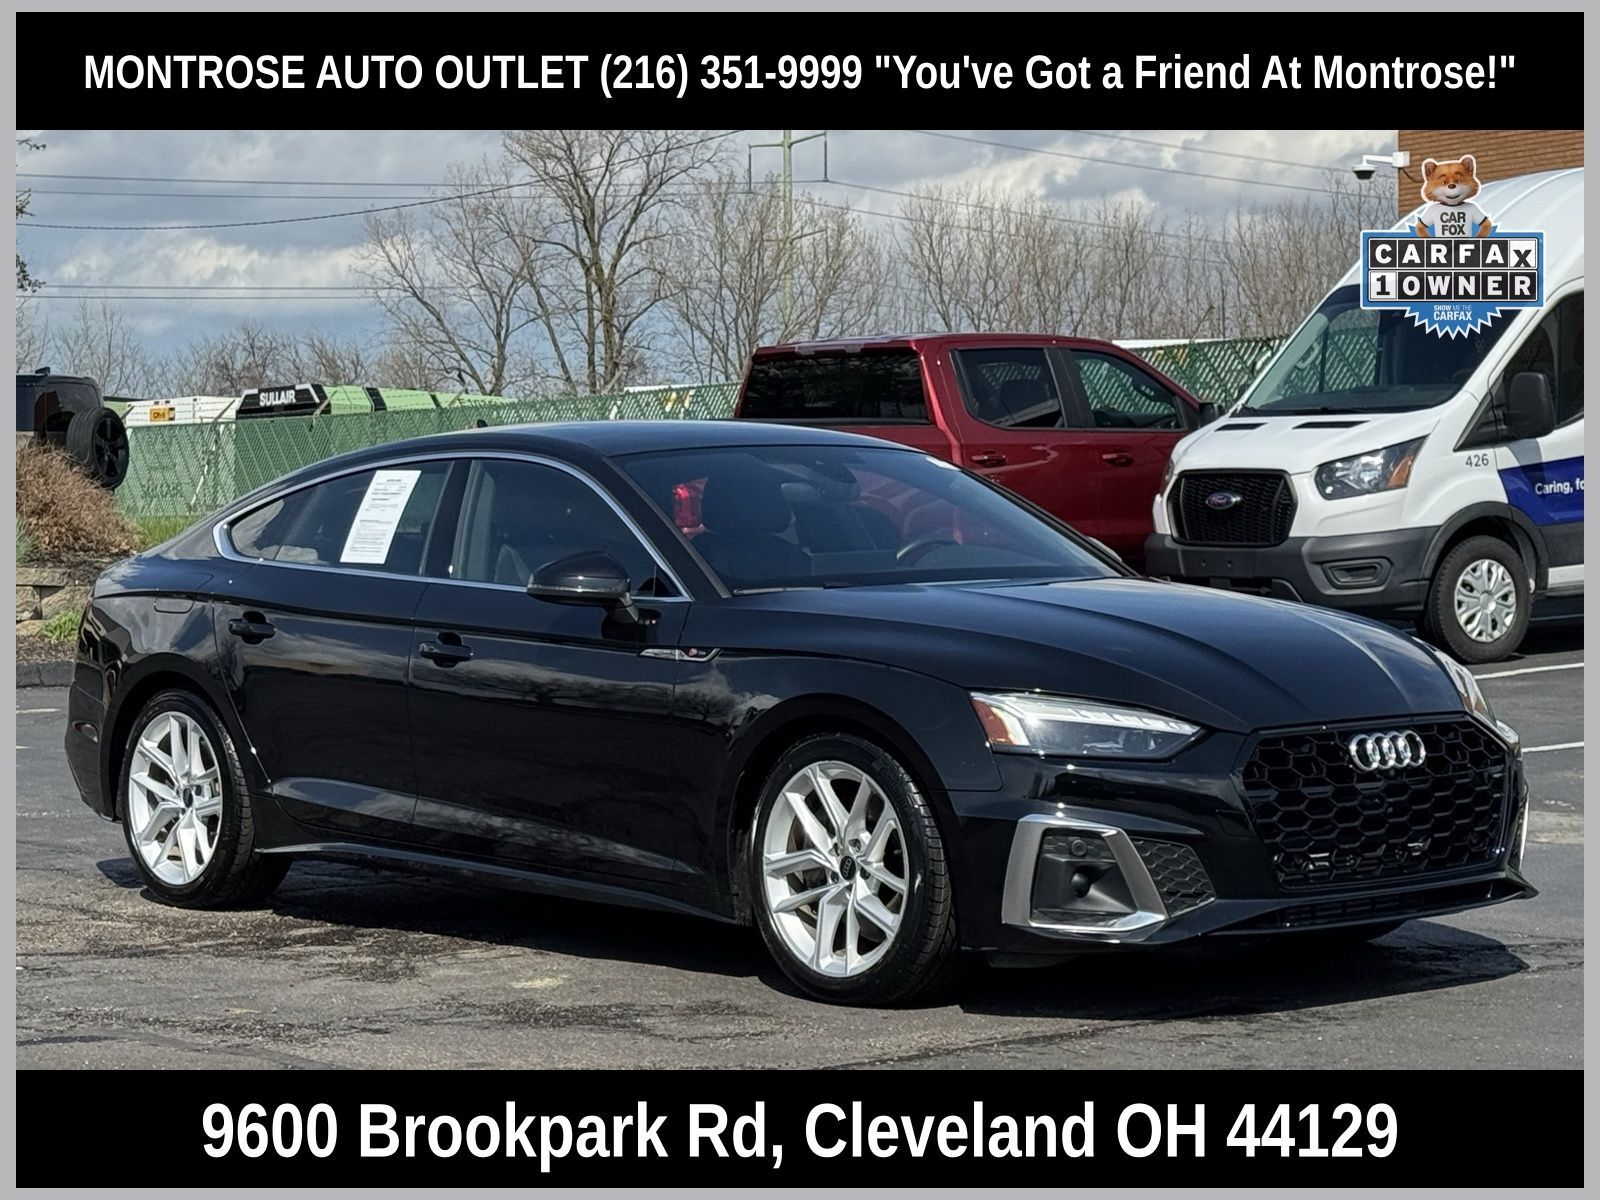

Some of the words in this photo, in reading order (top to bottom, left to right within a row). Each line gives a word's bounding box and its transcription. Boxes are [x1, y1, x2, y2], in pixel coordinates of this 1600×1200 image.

[258, 389, 297, 407] SULLAIR
[1465, 453, 1490, 467] 426
[1534, 480, 1574, 495] Caring,
